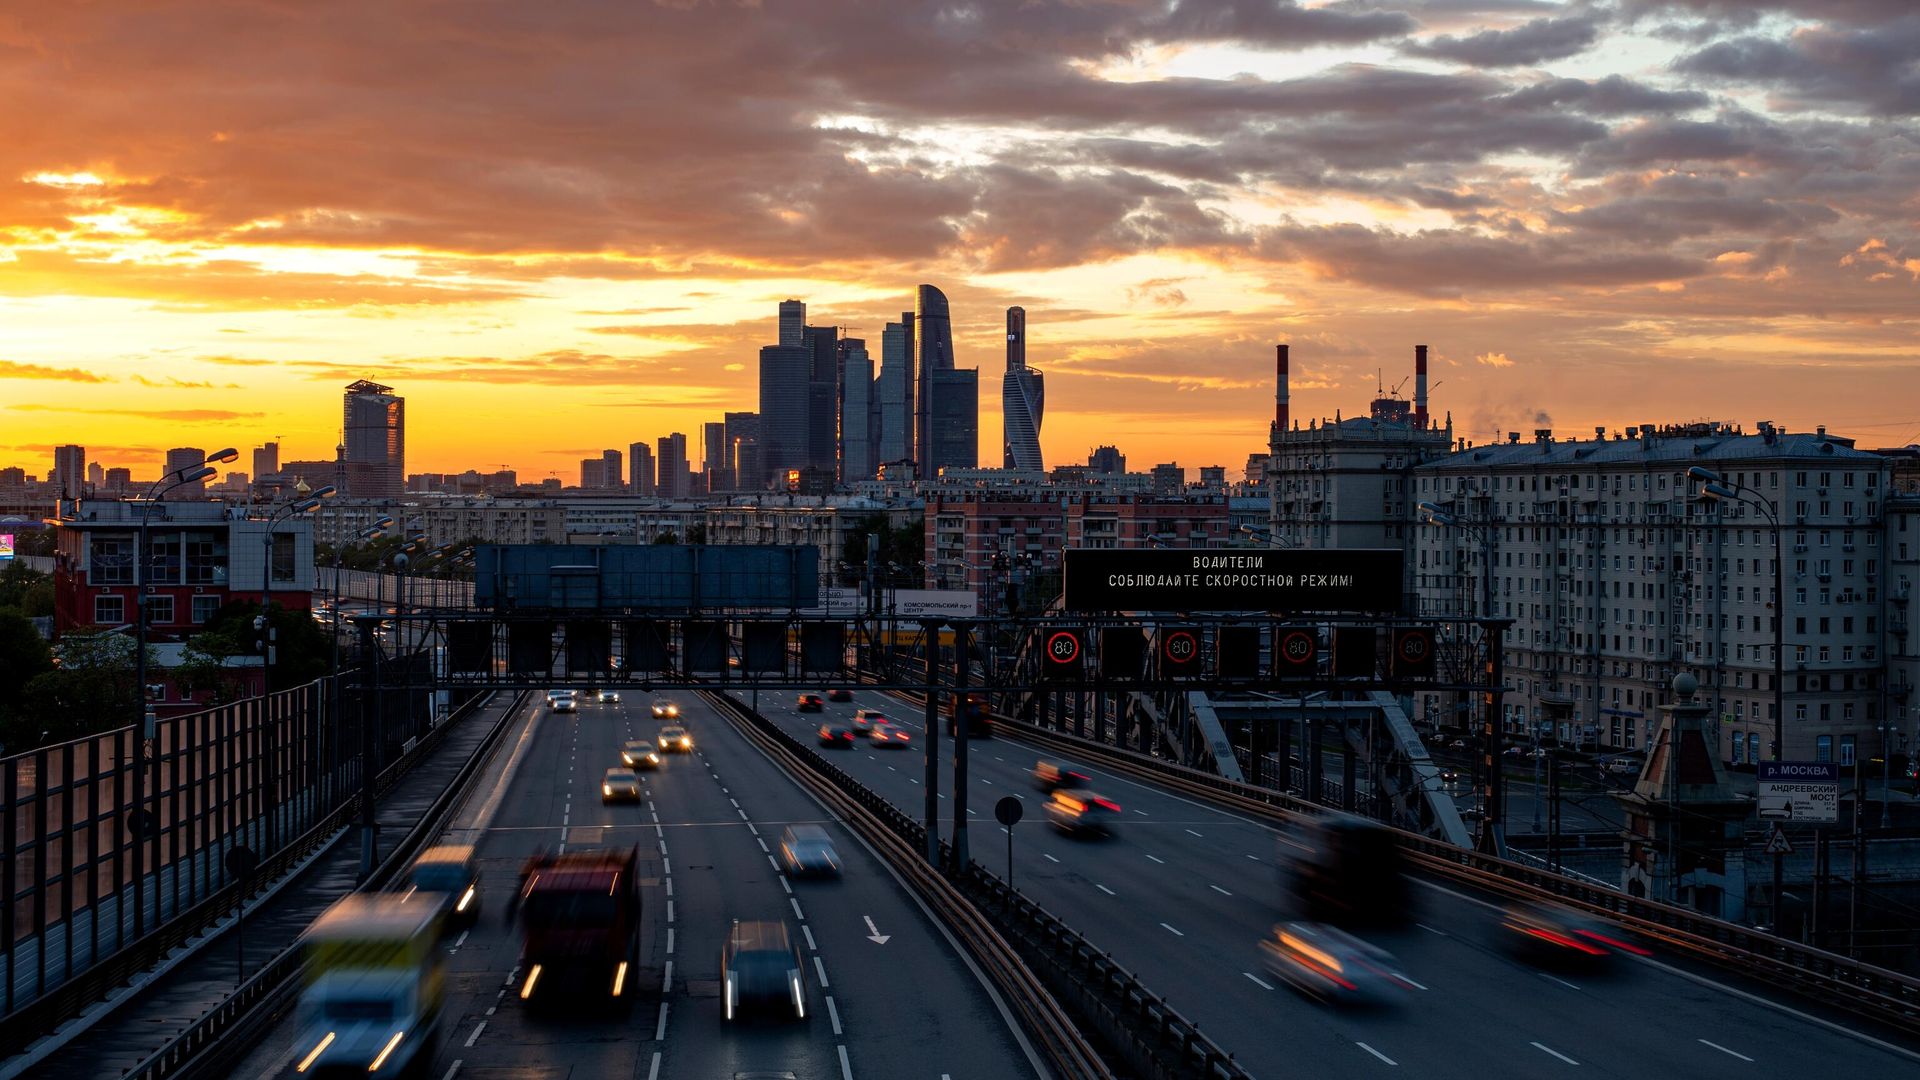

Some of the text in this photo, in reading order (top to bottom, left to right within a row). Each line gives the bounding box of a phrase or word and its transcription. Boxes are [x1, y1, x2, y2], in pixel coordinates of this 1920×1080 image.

[1193, 556, 1263, 568] ВОДИТЕЛИ
[1108, 574, 1353, 587] СОБЛЮДАЙТЕ СКОРОСТНОЙ РЕЖИМ!
[1054, 641, 1073, 654] 80
[1173, 641, 1190, 654] 80
[1289, 640, 1307, 654] 80
[1406, 640, 1423, 654] 80
[1768, 765, 1829, 776] р. МОСКВА
[1770, 784, 1836, 793] АНДРЕЕВСКИЙ
